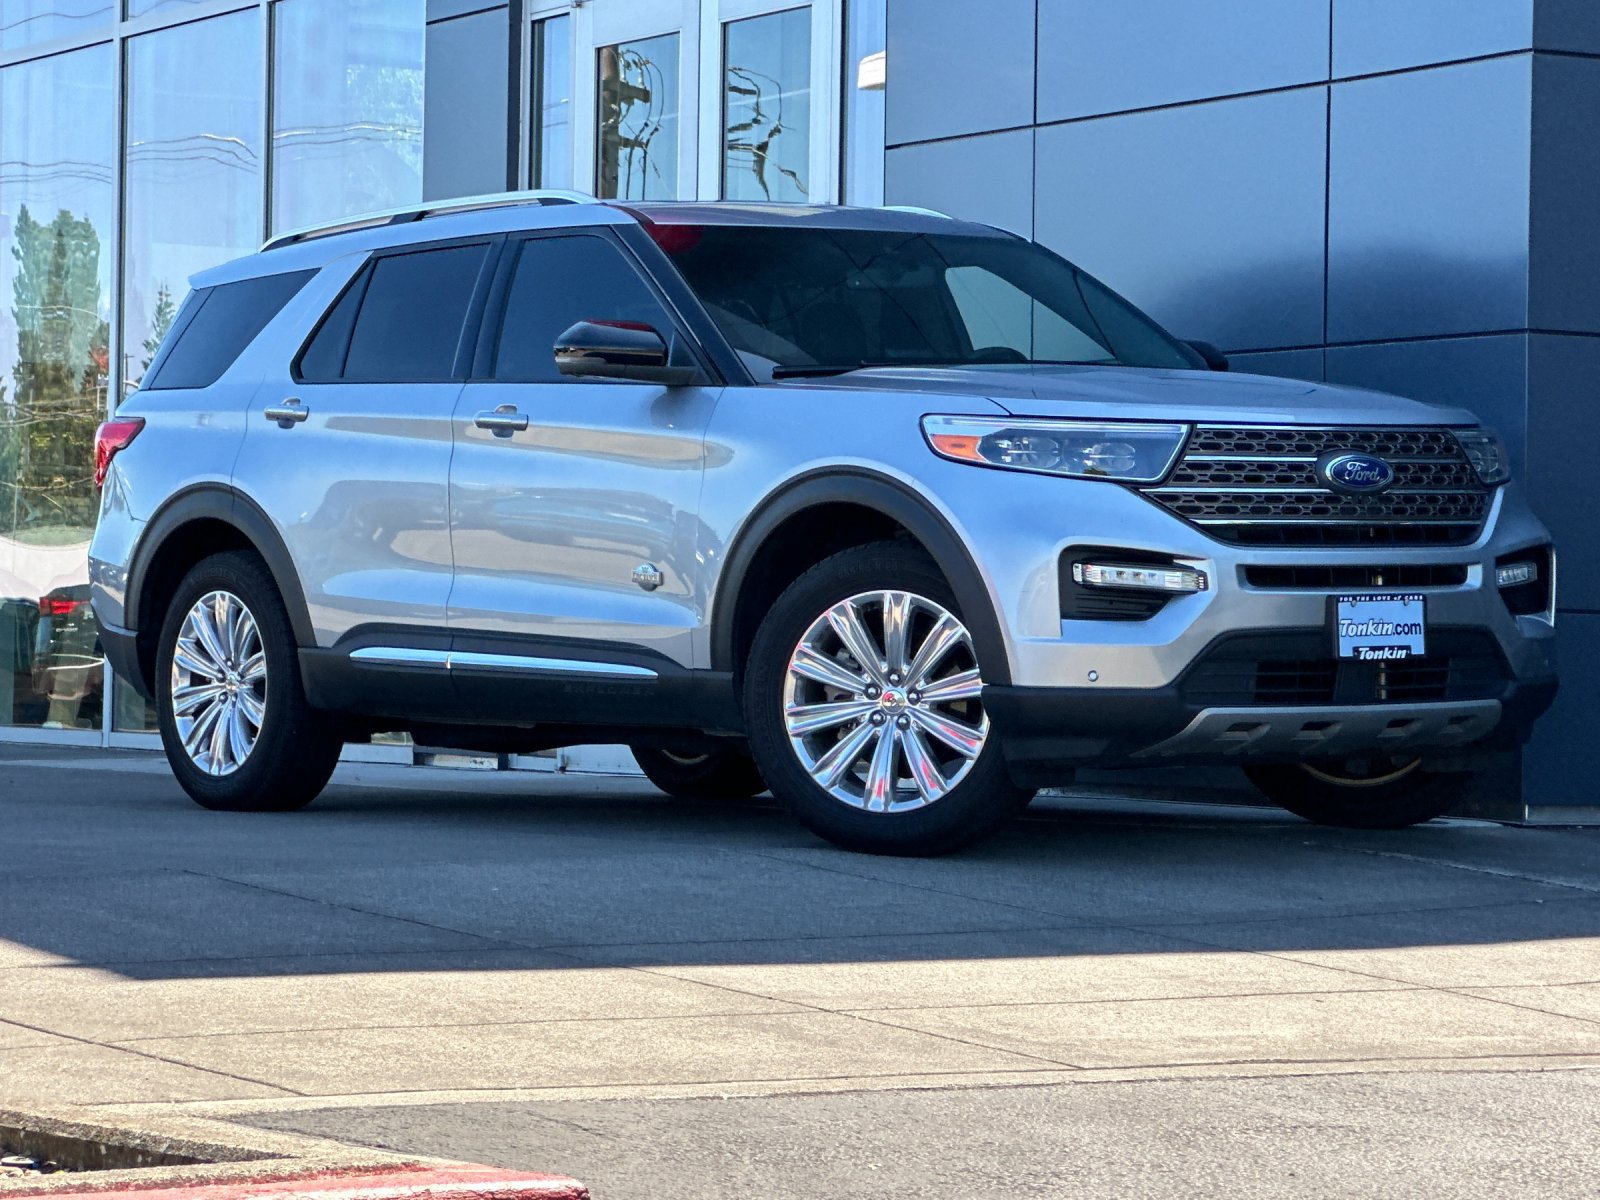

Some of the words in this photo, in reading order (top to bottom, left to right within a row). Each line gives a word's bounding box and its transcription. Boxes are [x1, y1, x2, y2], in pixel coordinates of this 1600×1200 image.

[1344, 461, 1380, 481] Ford
[1340, 618, 1422, 637] Tonkin.com
[1358, 647, 1407, 660] Tonkin
